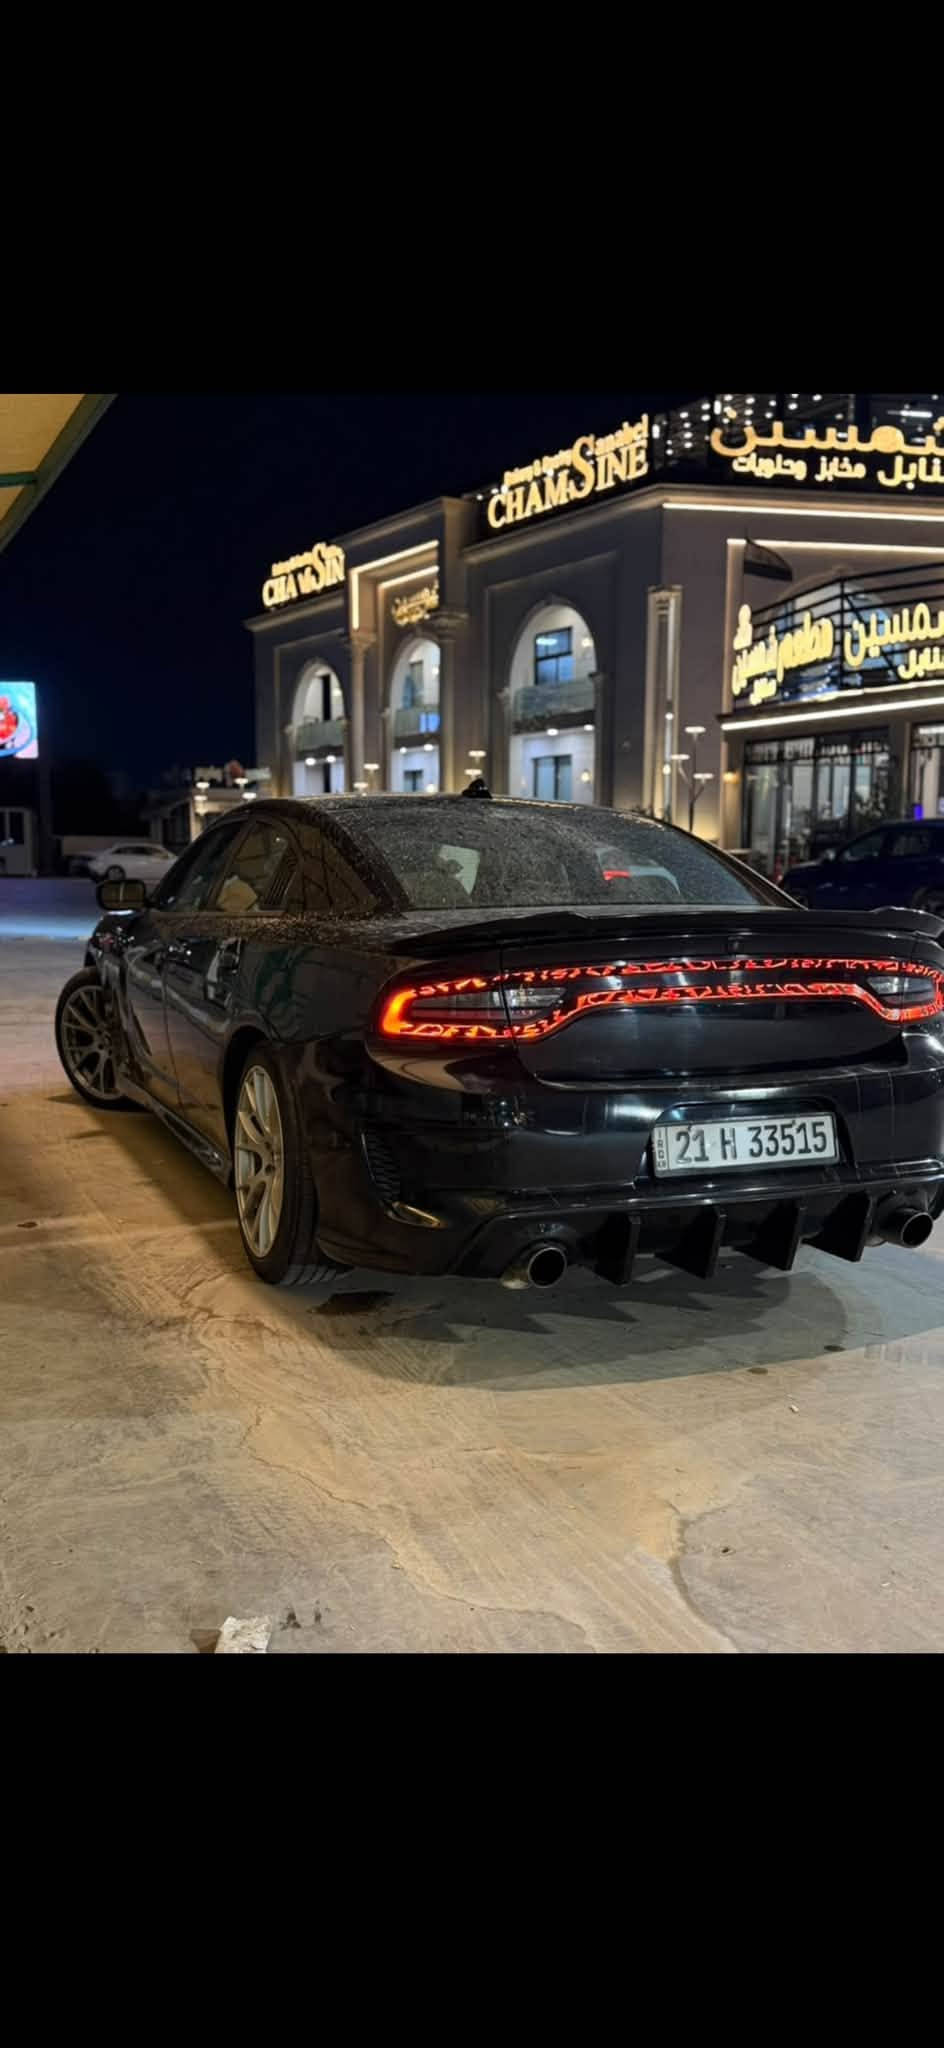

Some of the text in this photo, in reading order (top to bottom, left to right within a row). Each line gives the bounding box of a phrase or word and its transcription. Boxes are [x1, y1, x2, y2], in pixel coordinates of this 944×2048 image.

[675, 1121, 828, 1164] 21 H 33515
